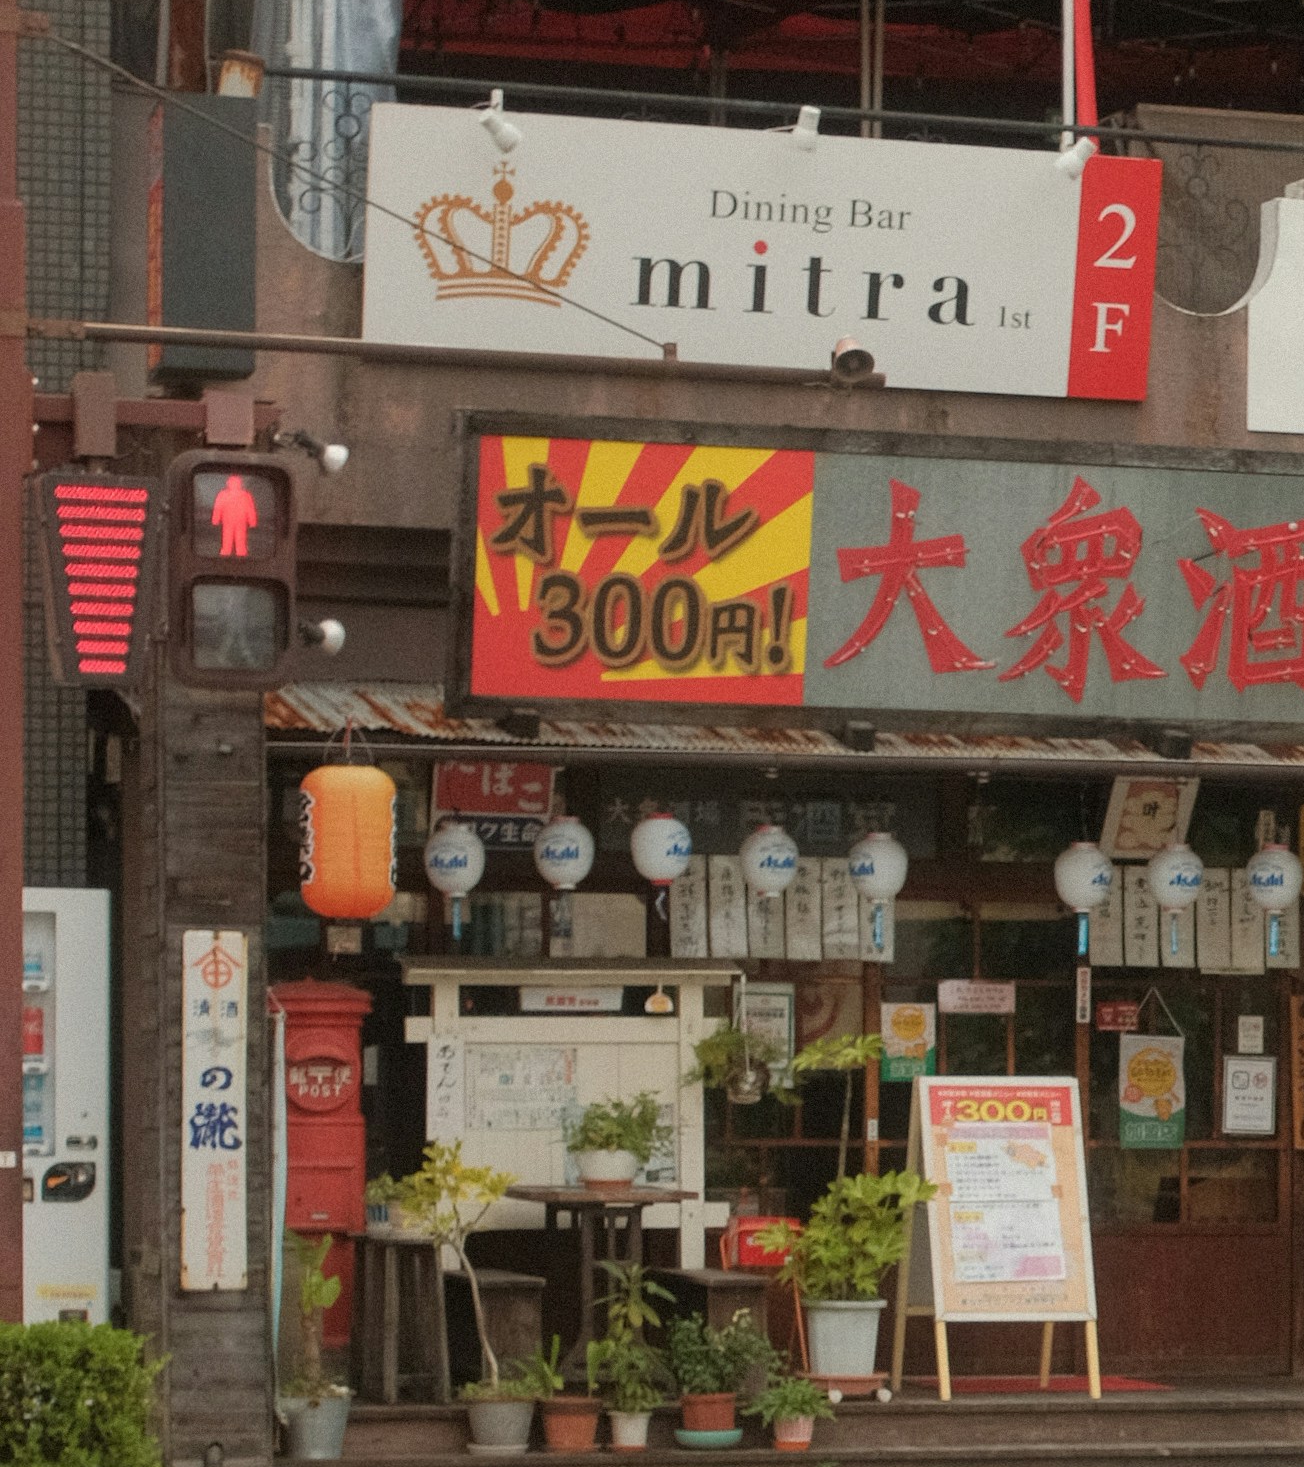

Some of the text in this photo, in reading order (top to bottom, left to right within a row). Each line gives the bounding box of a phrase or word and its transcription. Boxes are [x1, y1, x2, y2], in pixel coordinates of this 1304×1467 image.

[710, 189, 913, 235] Dining Bar
[630, 240, 976, 328] mitra
[490, 464, 758, 564] オール
[532, 570, 796, 674] 300円!
[443, 762, 545, 812] ばこ
[298, 1083, 343, 1099] POST
